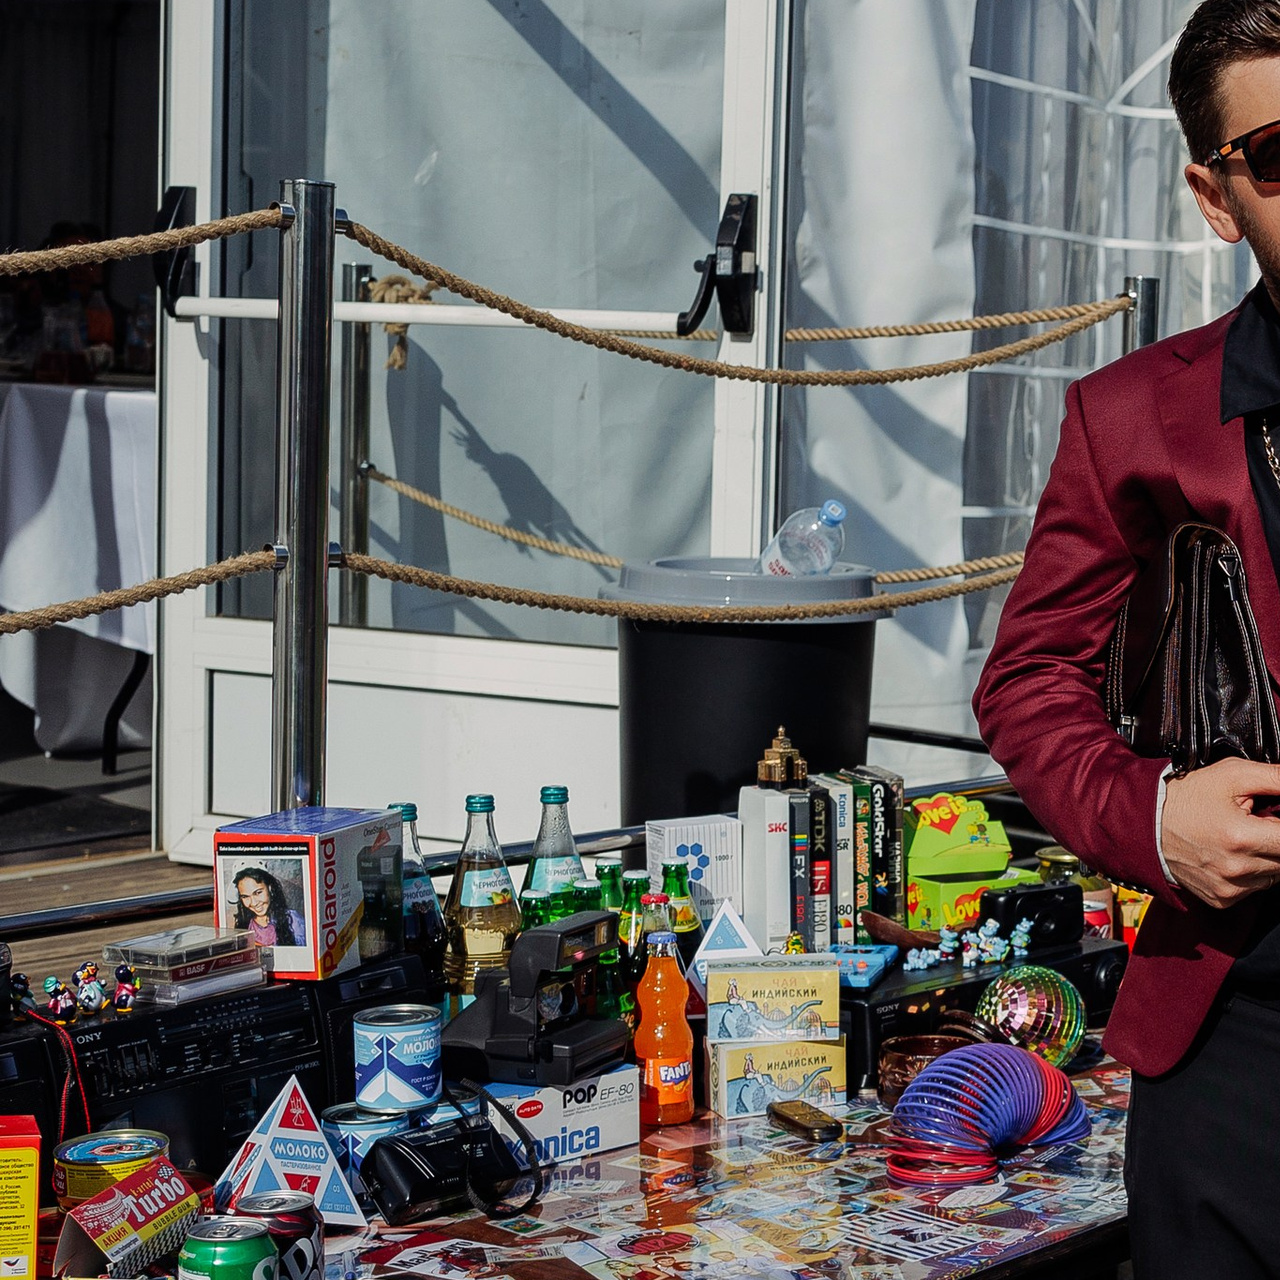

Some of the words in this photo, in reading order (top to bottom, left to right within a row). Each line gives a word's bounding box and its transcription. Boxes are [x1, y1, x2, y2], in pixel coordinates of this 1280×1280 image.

[838, 793, 848, 828] Konica
[767, 822, 788, 833] SKC
[872, 784, 886, 858] GoldStar
[814, 813, 826, 853] TDK
[320, 836, 338, 973] Polaroid
[186, 964, 206, 975] BASF
[752, 985, 817, 999] ИНДИЙСКИЙ
[772, 977, 797, 987] ЧАЙ
[876, 1003, 900, 1014] SONY
[72, 1031, 102, 1045] ONY
[785, 1045, 809, 1057] ЧАЙ
[767, 1053, 827, 1071] ИНДИЙСКИЙ
[562, 1084, 598, 1109] POP
[600, 1082, 635, 1101] EF-80
[274, 1141, 327, 1161] МОЛОКО
[122, 1176, 186, 1223] Turbo
[152, 1209, 178, 1231] BUBBLE
[177, 1200, 192, 1216] GUM
[101, 1226, 129, 1249] АКЦИЯ
